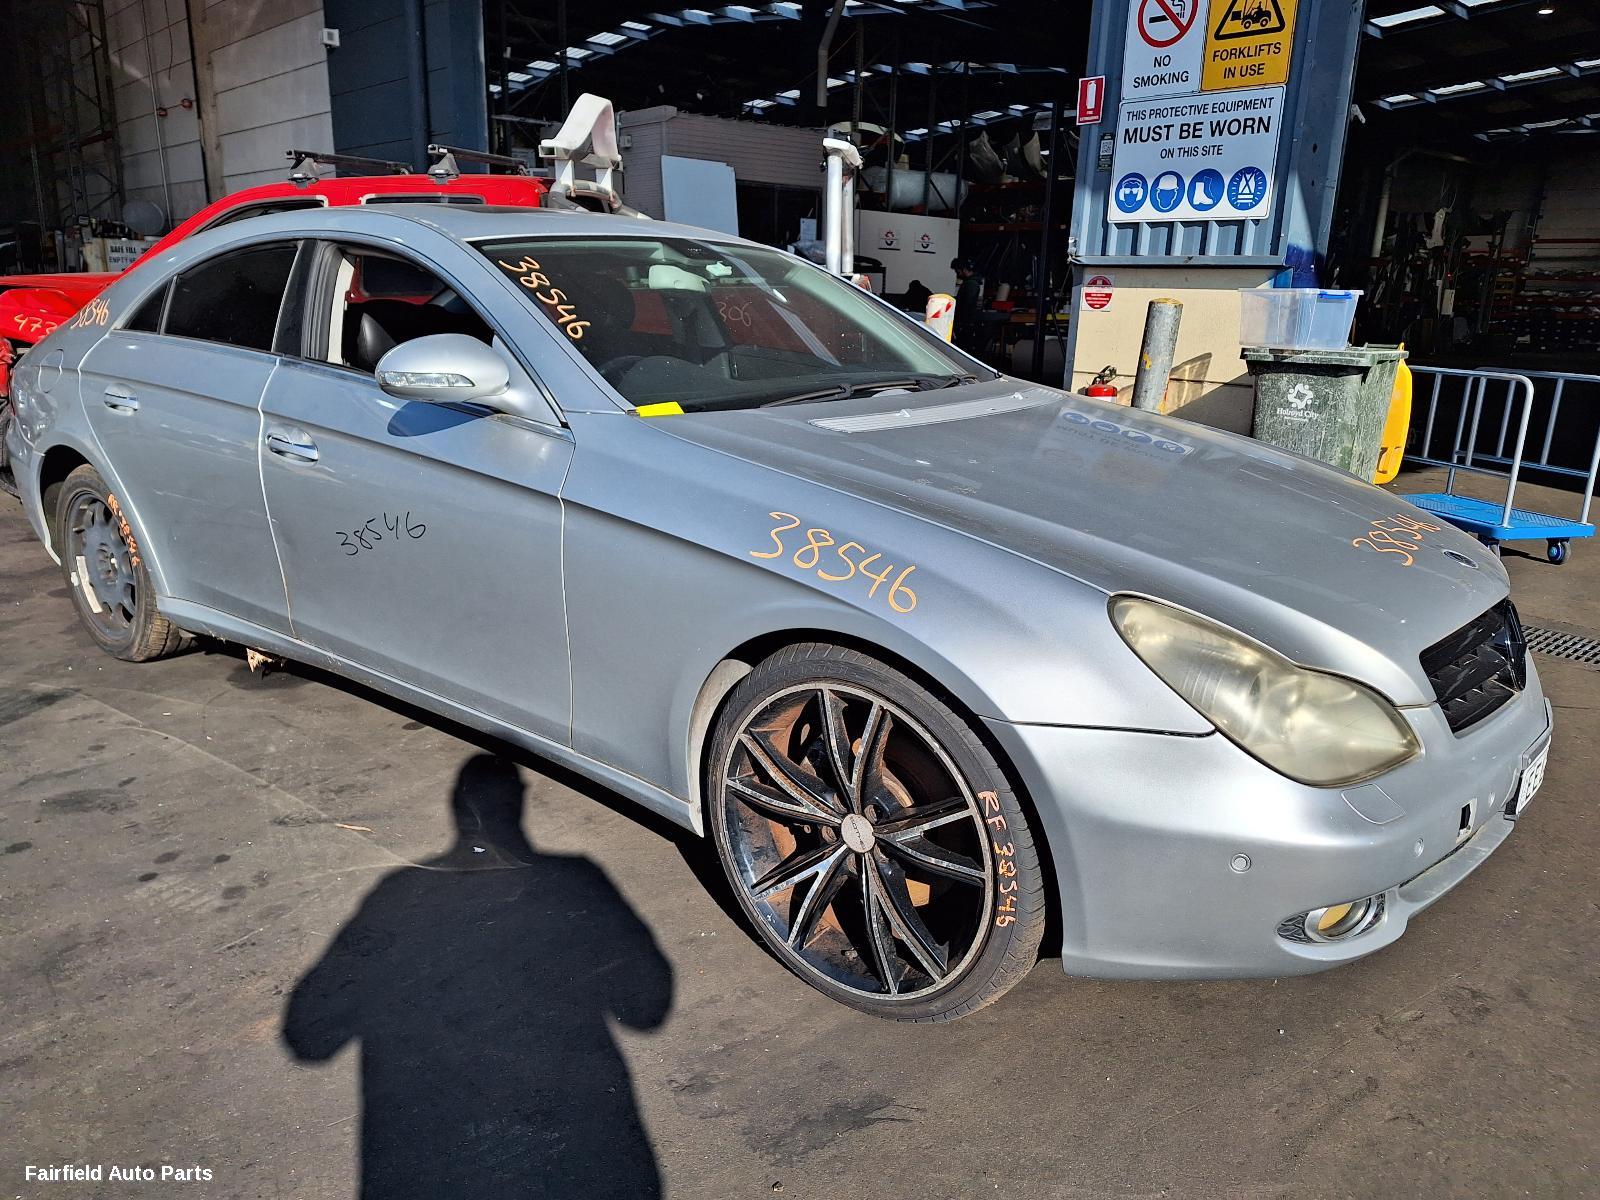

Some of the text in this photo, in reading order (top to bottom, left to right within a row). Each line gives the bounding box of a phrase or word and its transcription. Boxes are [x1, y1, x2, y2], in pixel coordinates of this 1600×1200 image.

[1153, 54, 1172, 68] NO
[1212, 42, 1282, 62] FORKLIFTS
[1133, 70, 1190, 88] SMOKING
[1223, 63, 1265, 79] IN USE
[1126, 97, 1275, 121] THIS PROTECTIVE EQUIPMENT
[1123, 116, 1272, 144] MUST BE WORN
[1160, 144, 1224, 159] ON THIS SITE
[499, 256, 592, 340] 38546
[335, 511, 426, 556] 38546
[750, 511, 917, 613] 38546
